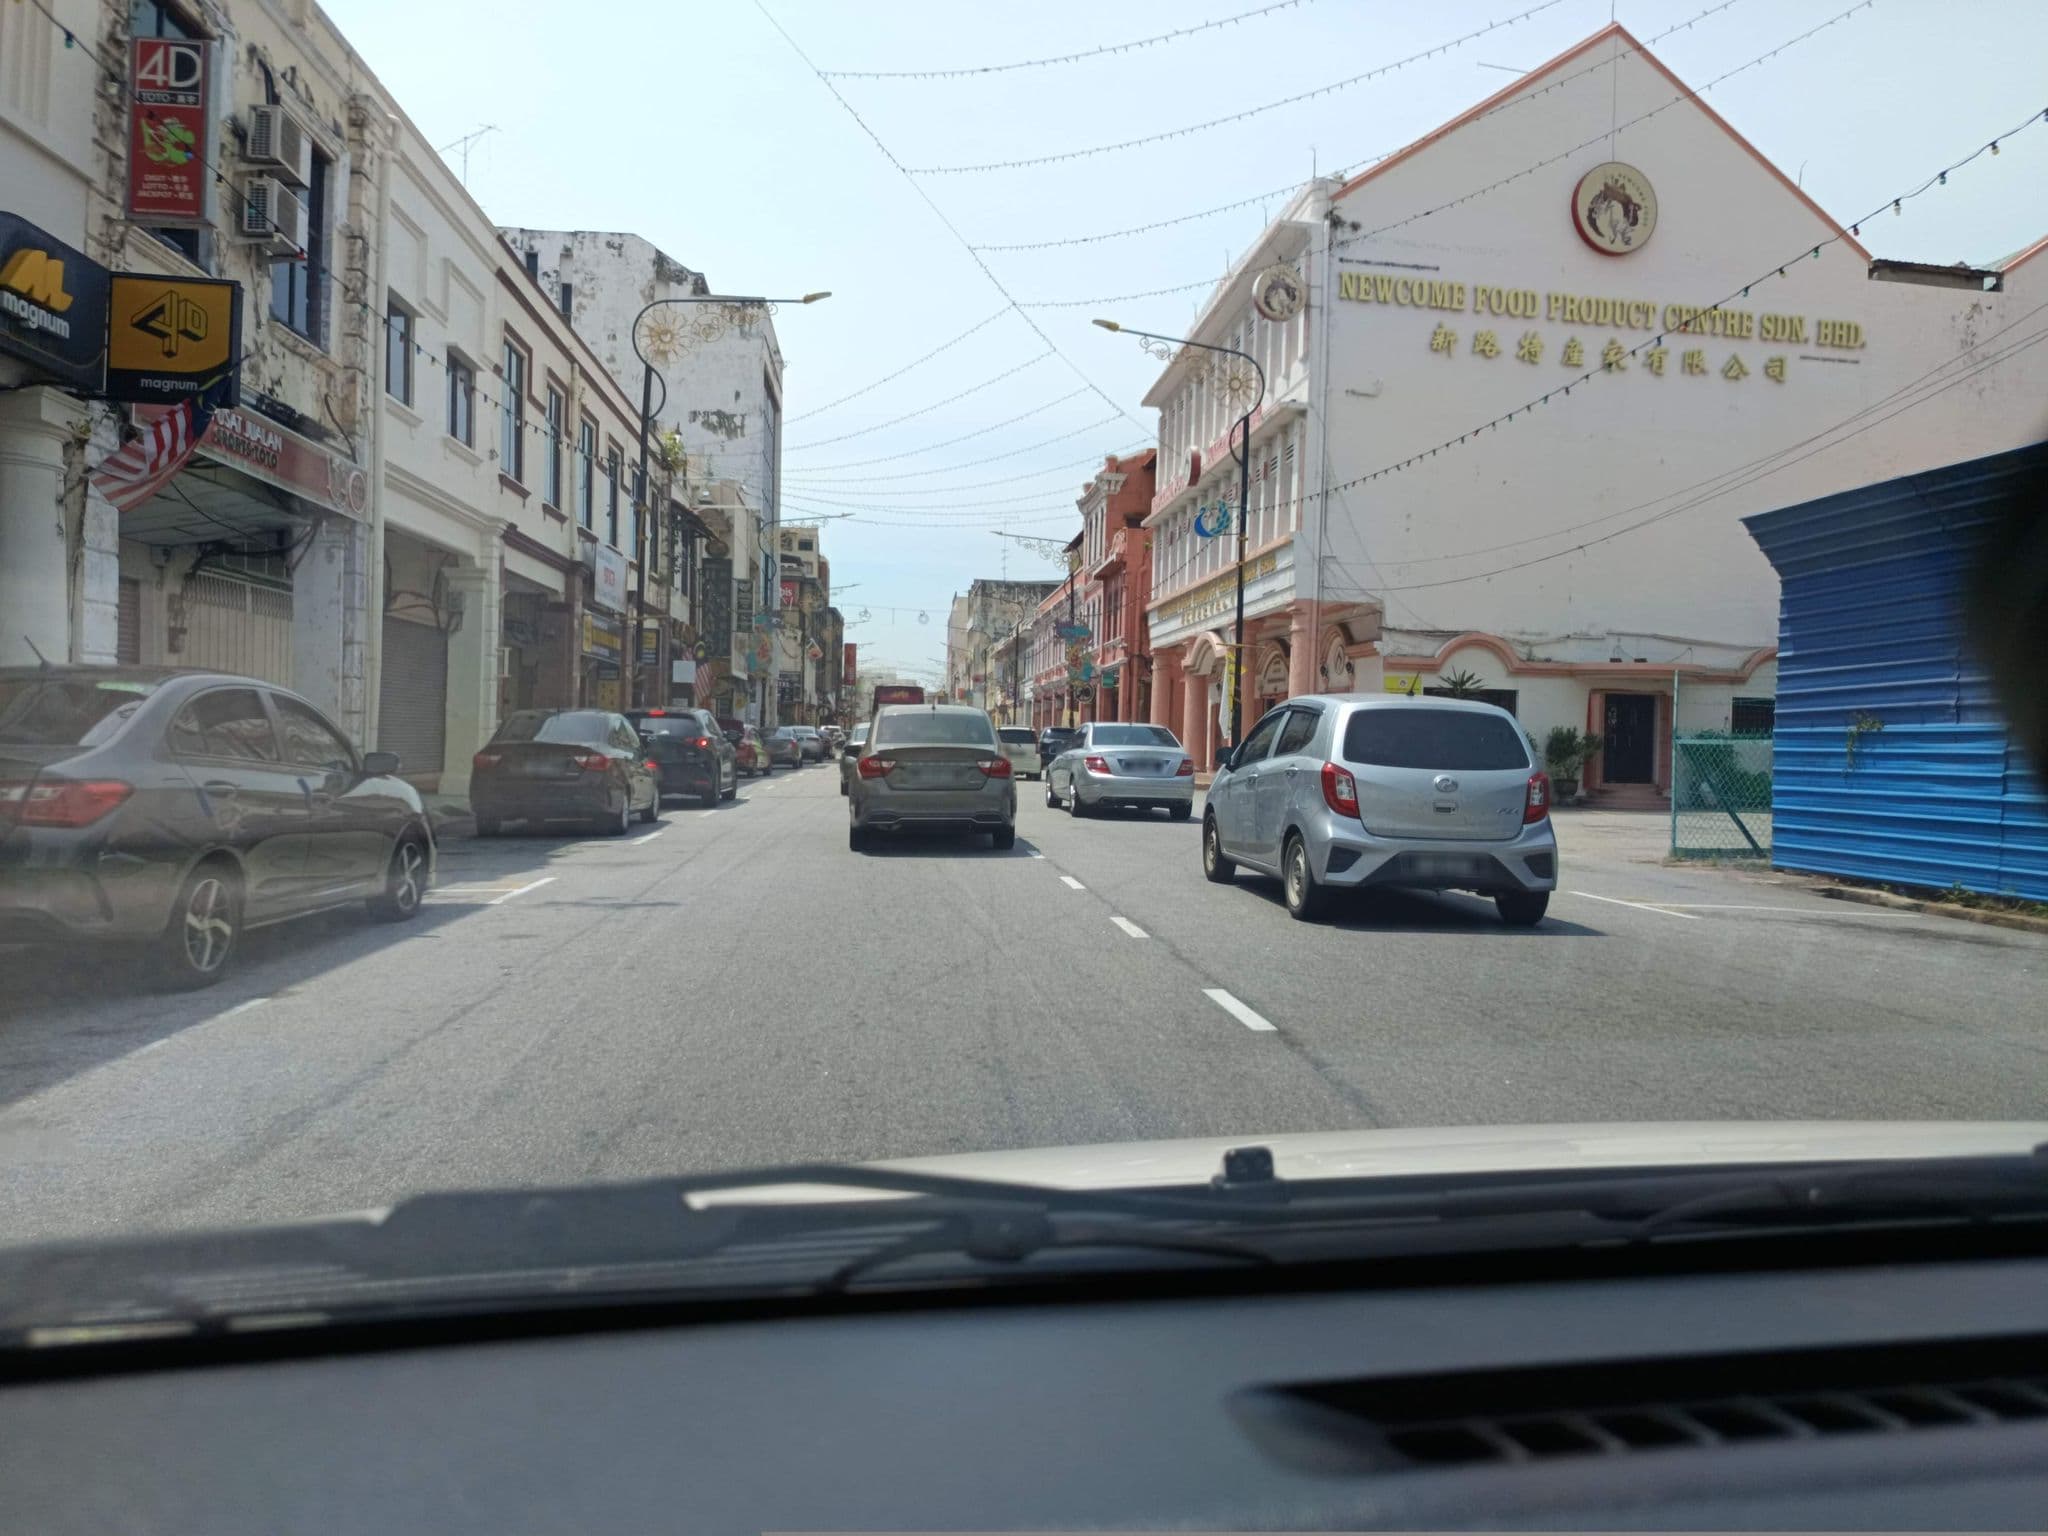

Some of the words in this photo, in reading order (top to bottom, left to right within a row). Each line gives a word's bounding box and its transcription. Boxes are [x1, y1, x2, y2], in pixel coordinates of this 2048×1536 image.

[136, 45, 203, 88] 4D
[2, 290, 71, 340] magnum
[130, 289, 209, 359] 4D
[1338, 271, 1466, 312] NEWCOME
[1473, 284, 1540, 319] FOOD
[1547, 292, 1657, 330] PRODUCT
[1663, 303, 1753, 338] CENTRE
[1760, 313, 1809, 345] SDN.
[1815, 319, 1867, 350] BHD.
[140, 376, 199, 392] magnum
[243, 419, 283, 454] JUALAN
